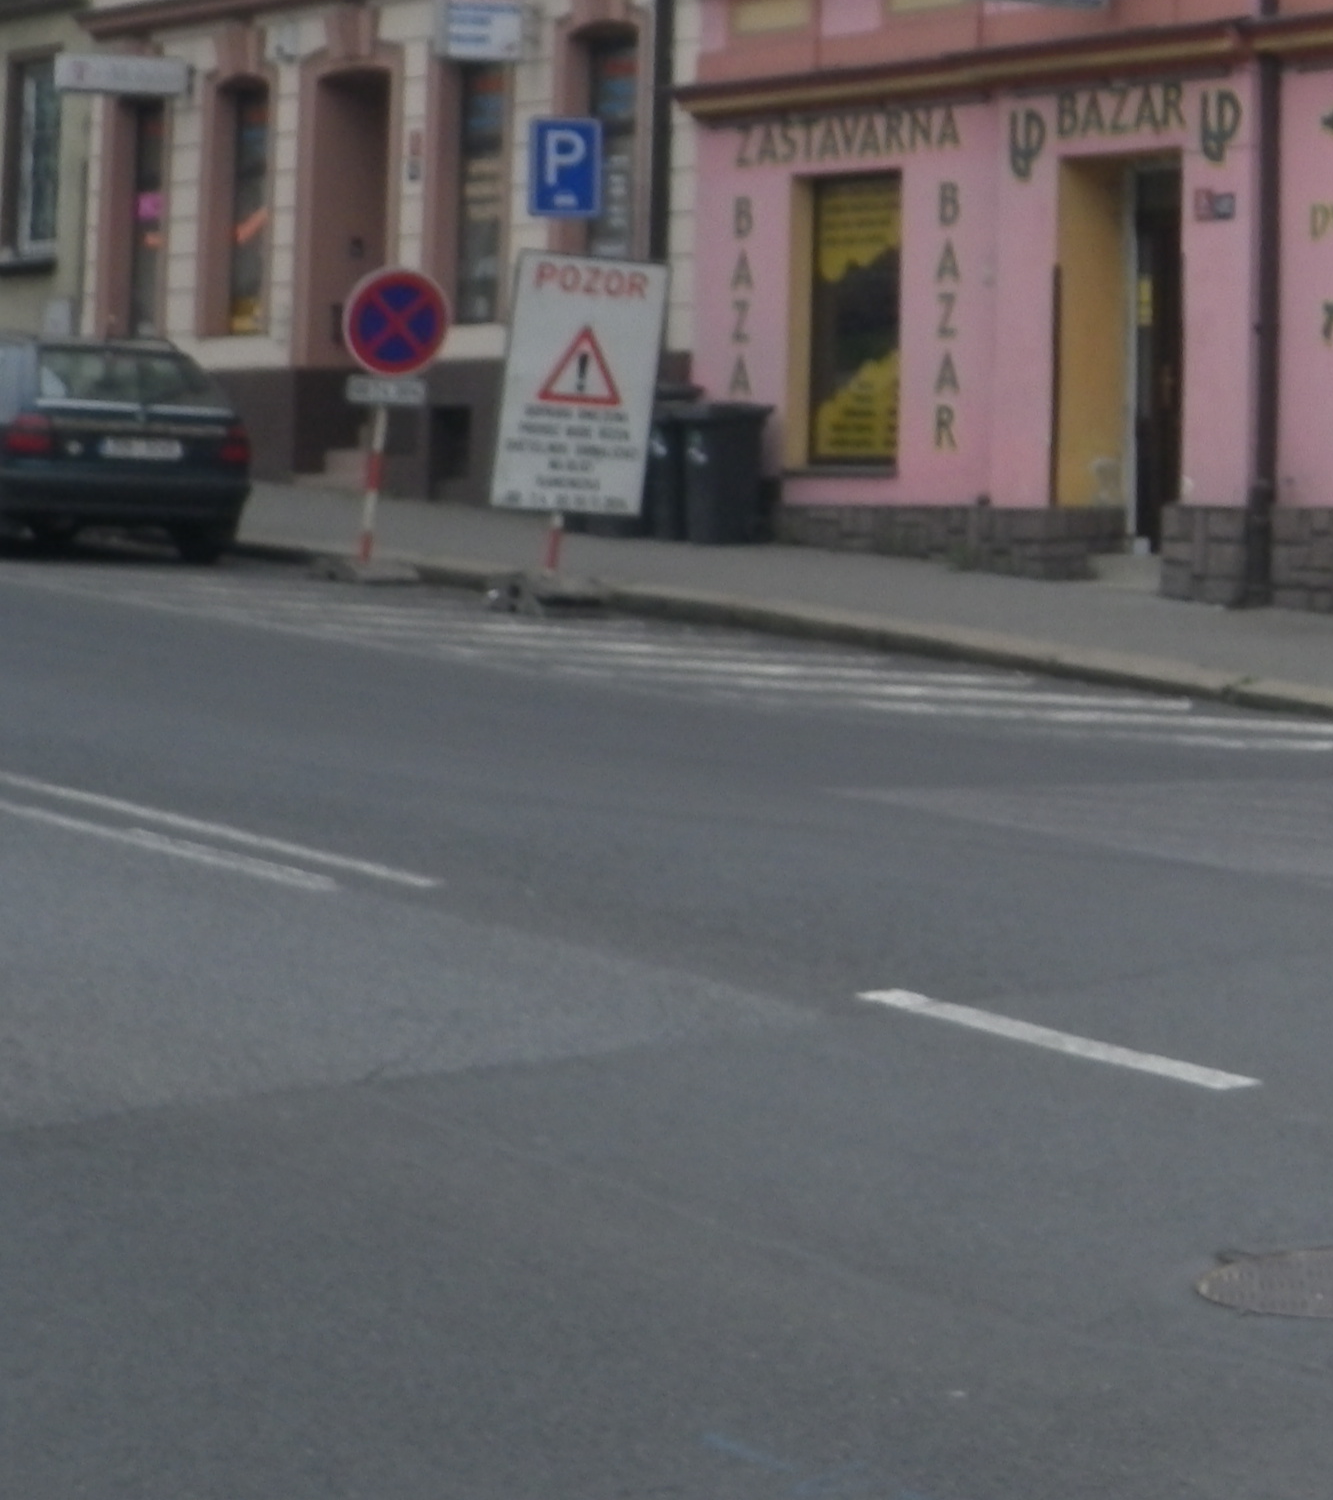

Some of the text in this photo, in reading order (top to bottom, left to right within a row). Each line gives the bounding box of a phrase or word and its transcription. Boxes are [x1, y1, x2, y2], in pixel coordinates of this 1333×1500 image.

[1056, 81, 1186, 137] BAZAR
[544, 128, 587, 187] P
[533, 261, 650, 300] POZOR
[932, 180, 962, 451] BAZAR
